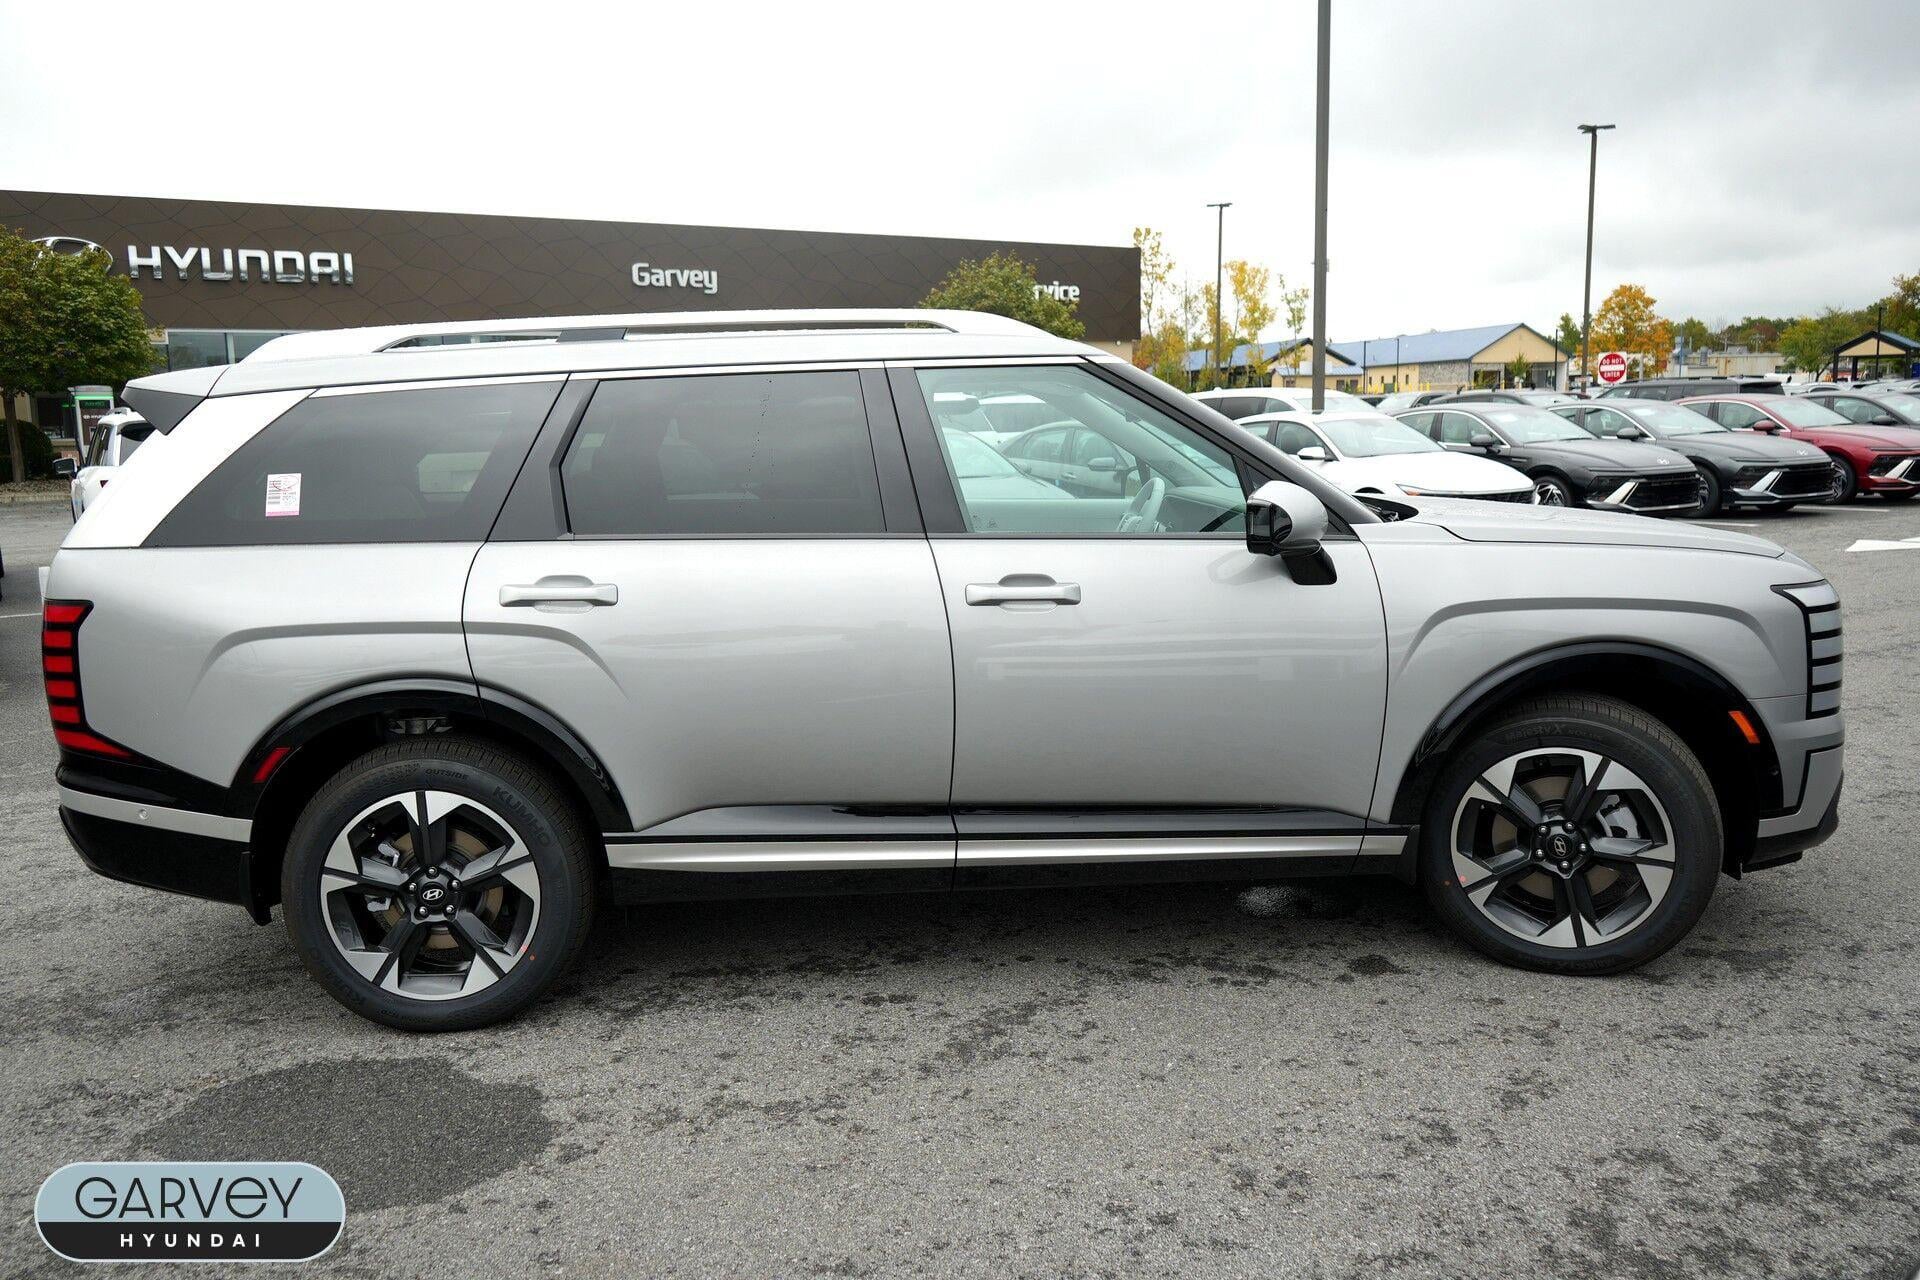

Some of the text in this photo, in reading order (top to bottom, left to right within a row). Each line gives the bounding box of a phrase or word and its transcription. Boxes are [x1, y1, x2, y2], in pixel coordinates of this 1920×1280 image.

[127, 245, 354, 286] HYUNDAI
[632, 262, 718, 294] Garvey
[1032, 280, 1080, 301] rvice
[493, 786, 550, 847] KUMHO
